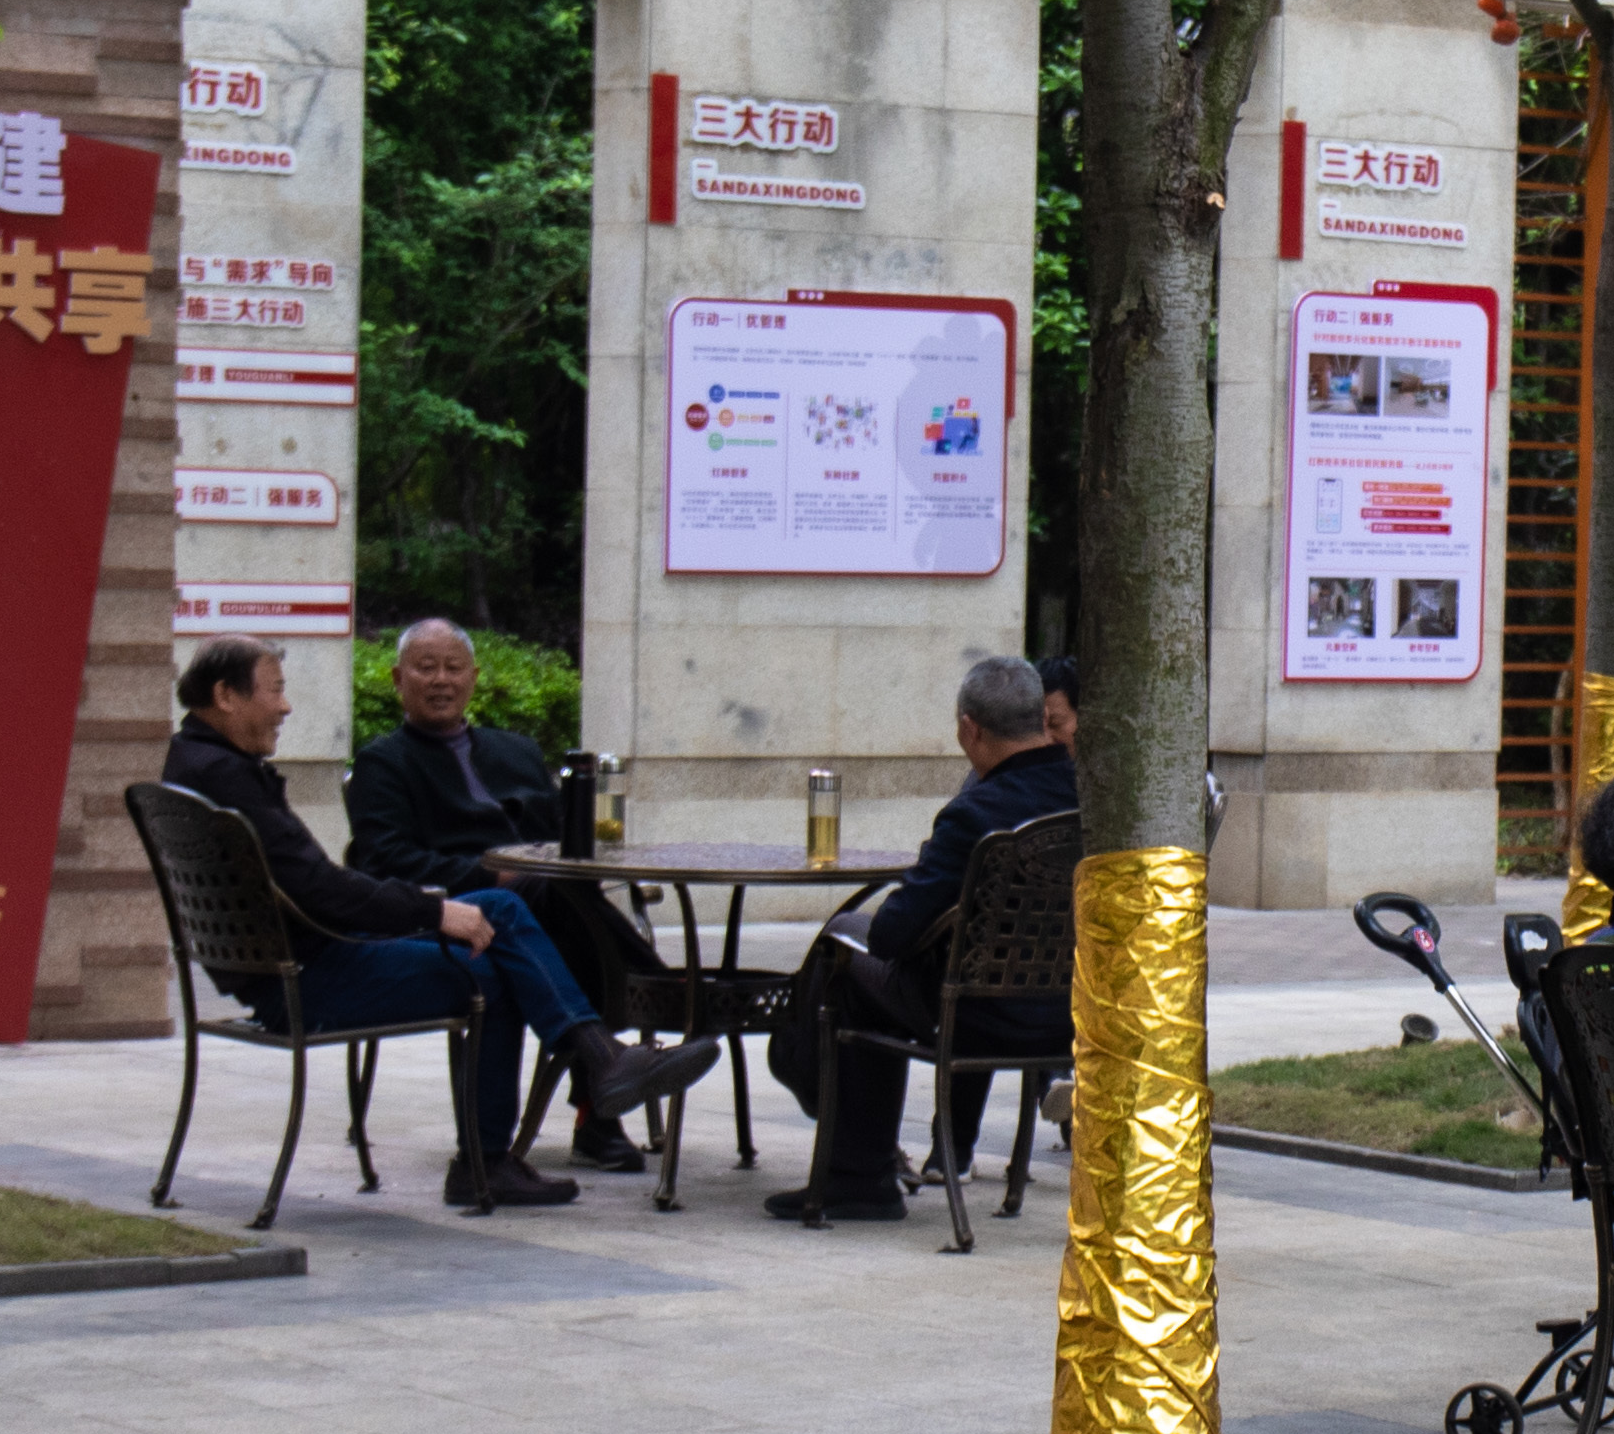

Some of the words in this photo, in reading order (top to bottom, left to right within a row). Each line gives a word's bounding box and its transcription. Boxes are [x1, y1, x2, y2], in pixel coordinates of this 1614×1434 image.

[697, 103, 834, 147] 三大行动
[1323, 148, 1440, 188] 三大行动
[696, 179, 862, 203] SANDAXINGDONG
[1323, 217, 1465, 242] SANDAXINGDONG
